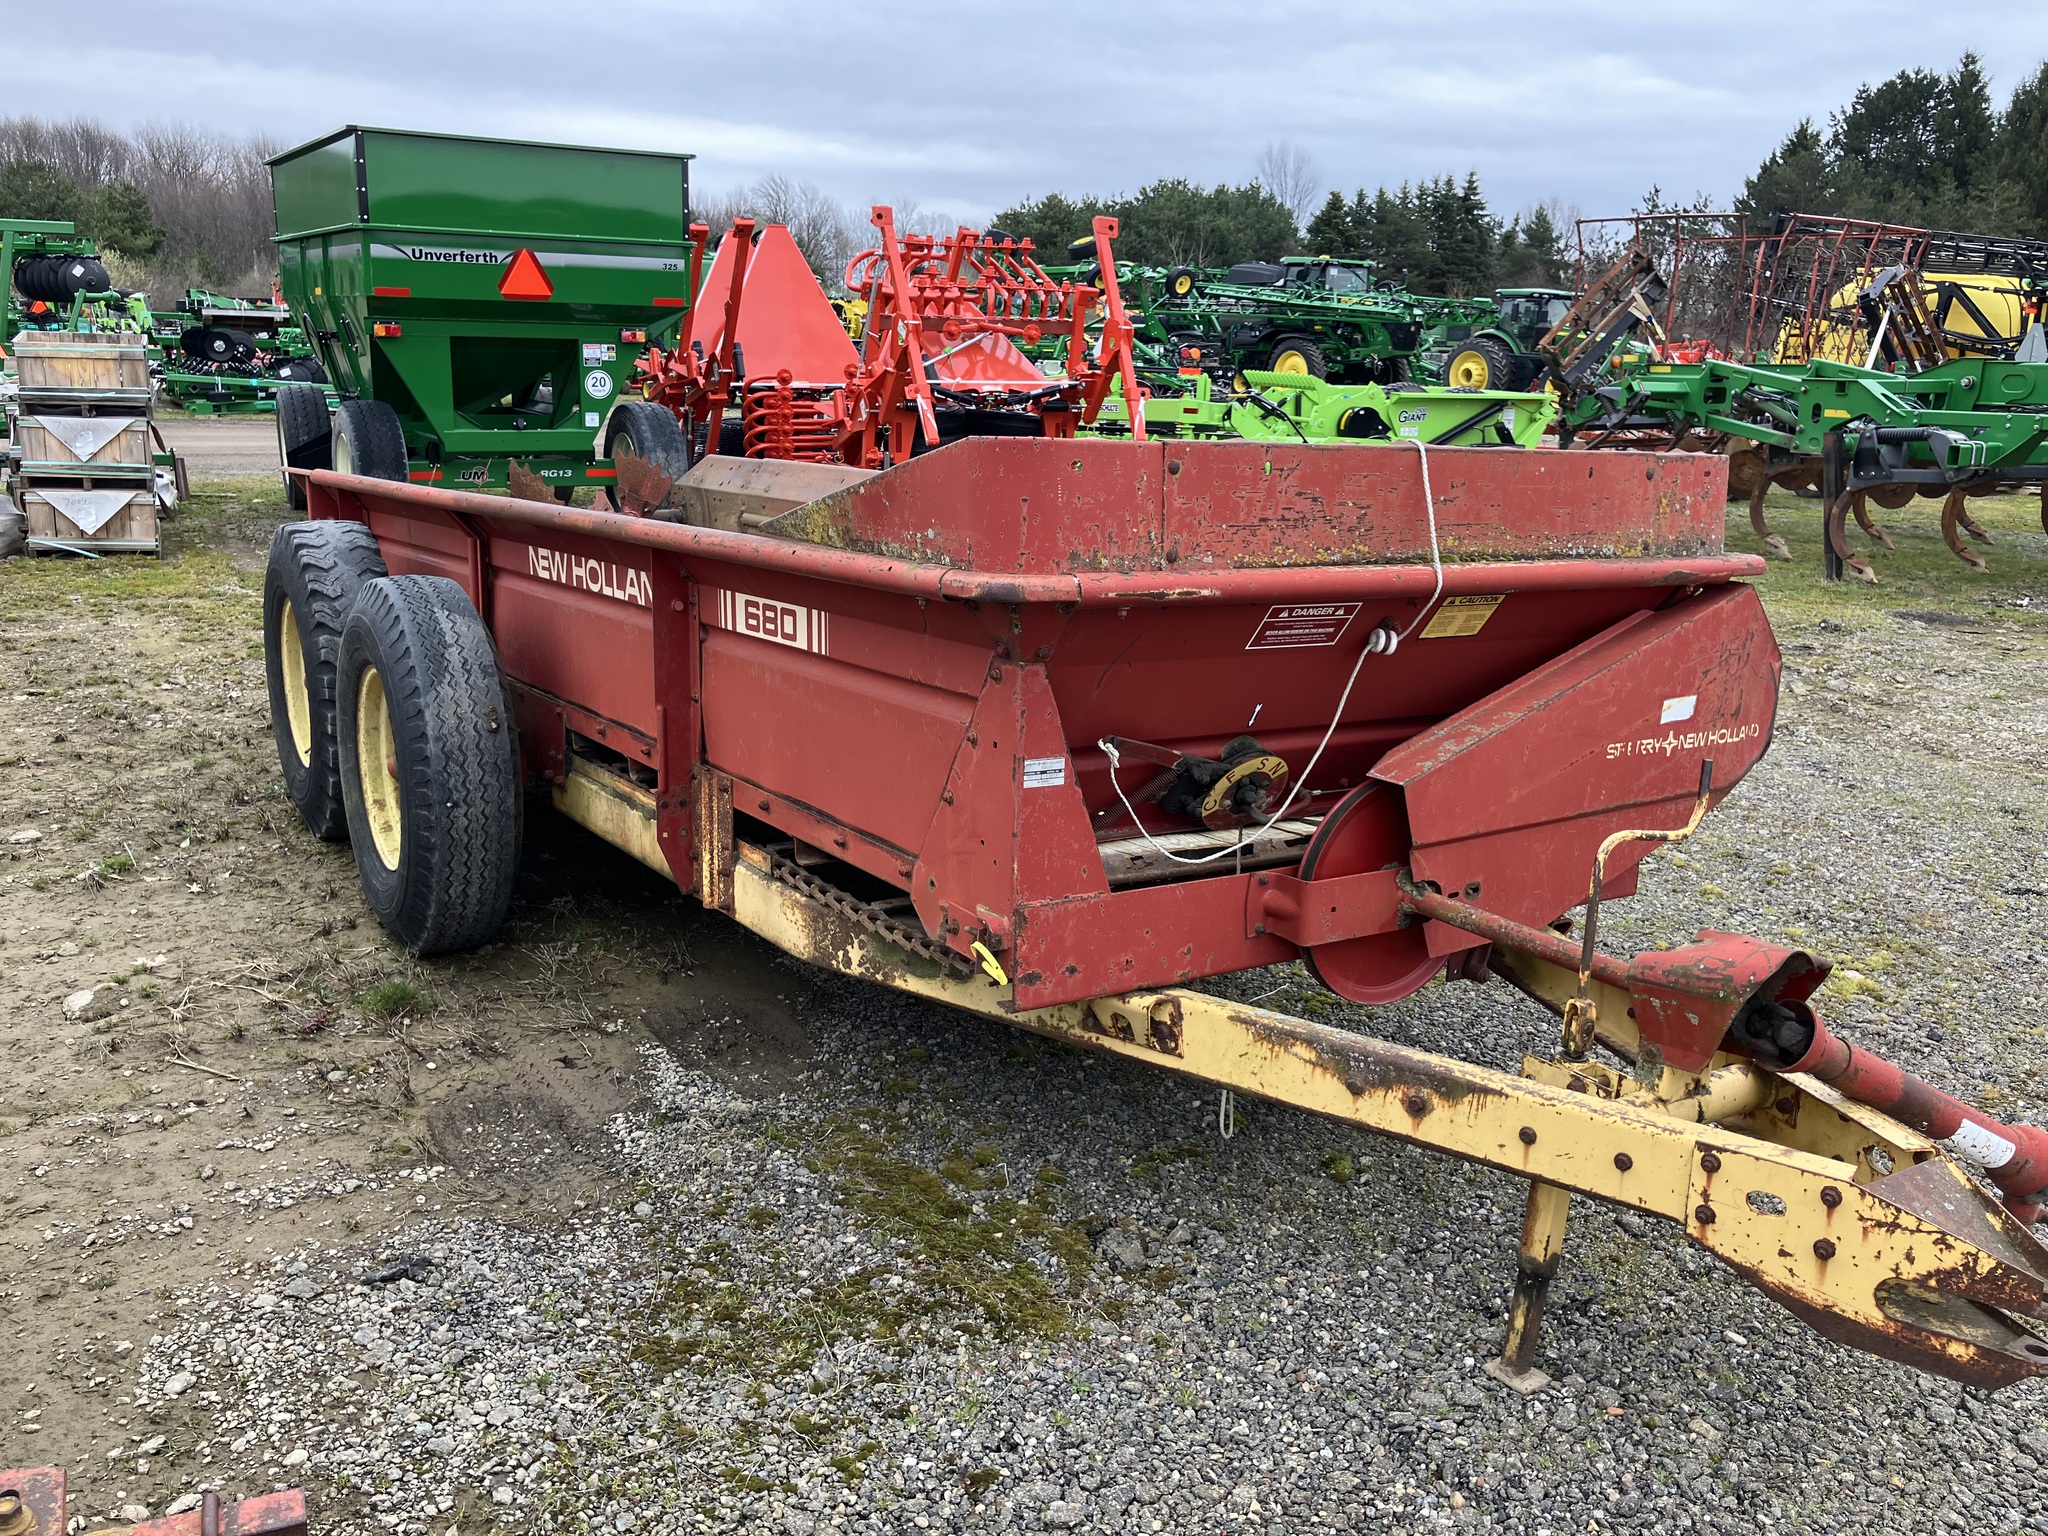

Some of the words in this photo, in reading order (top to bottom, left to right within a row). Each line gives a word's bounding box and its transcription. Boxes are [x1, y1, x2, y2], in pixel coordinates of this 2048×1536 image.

[411, 247, 499, 264] Unverferth
[662, 263, 678, 271] 325
[591, 376, 607, 388] 20
[461, 470, 487, 481] UM
[540, 469, 573, 478] RG13
[528, 545, 568, 584] NEW
[571, 555, 653, 607] HOLLAN
[1459, 595, 1501, 605] CAUTION
[1291, 607, 1335, 617] DANGER
[744, 598, 798, 643] 680
[1677, 731, 1707, 750] NEW
